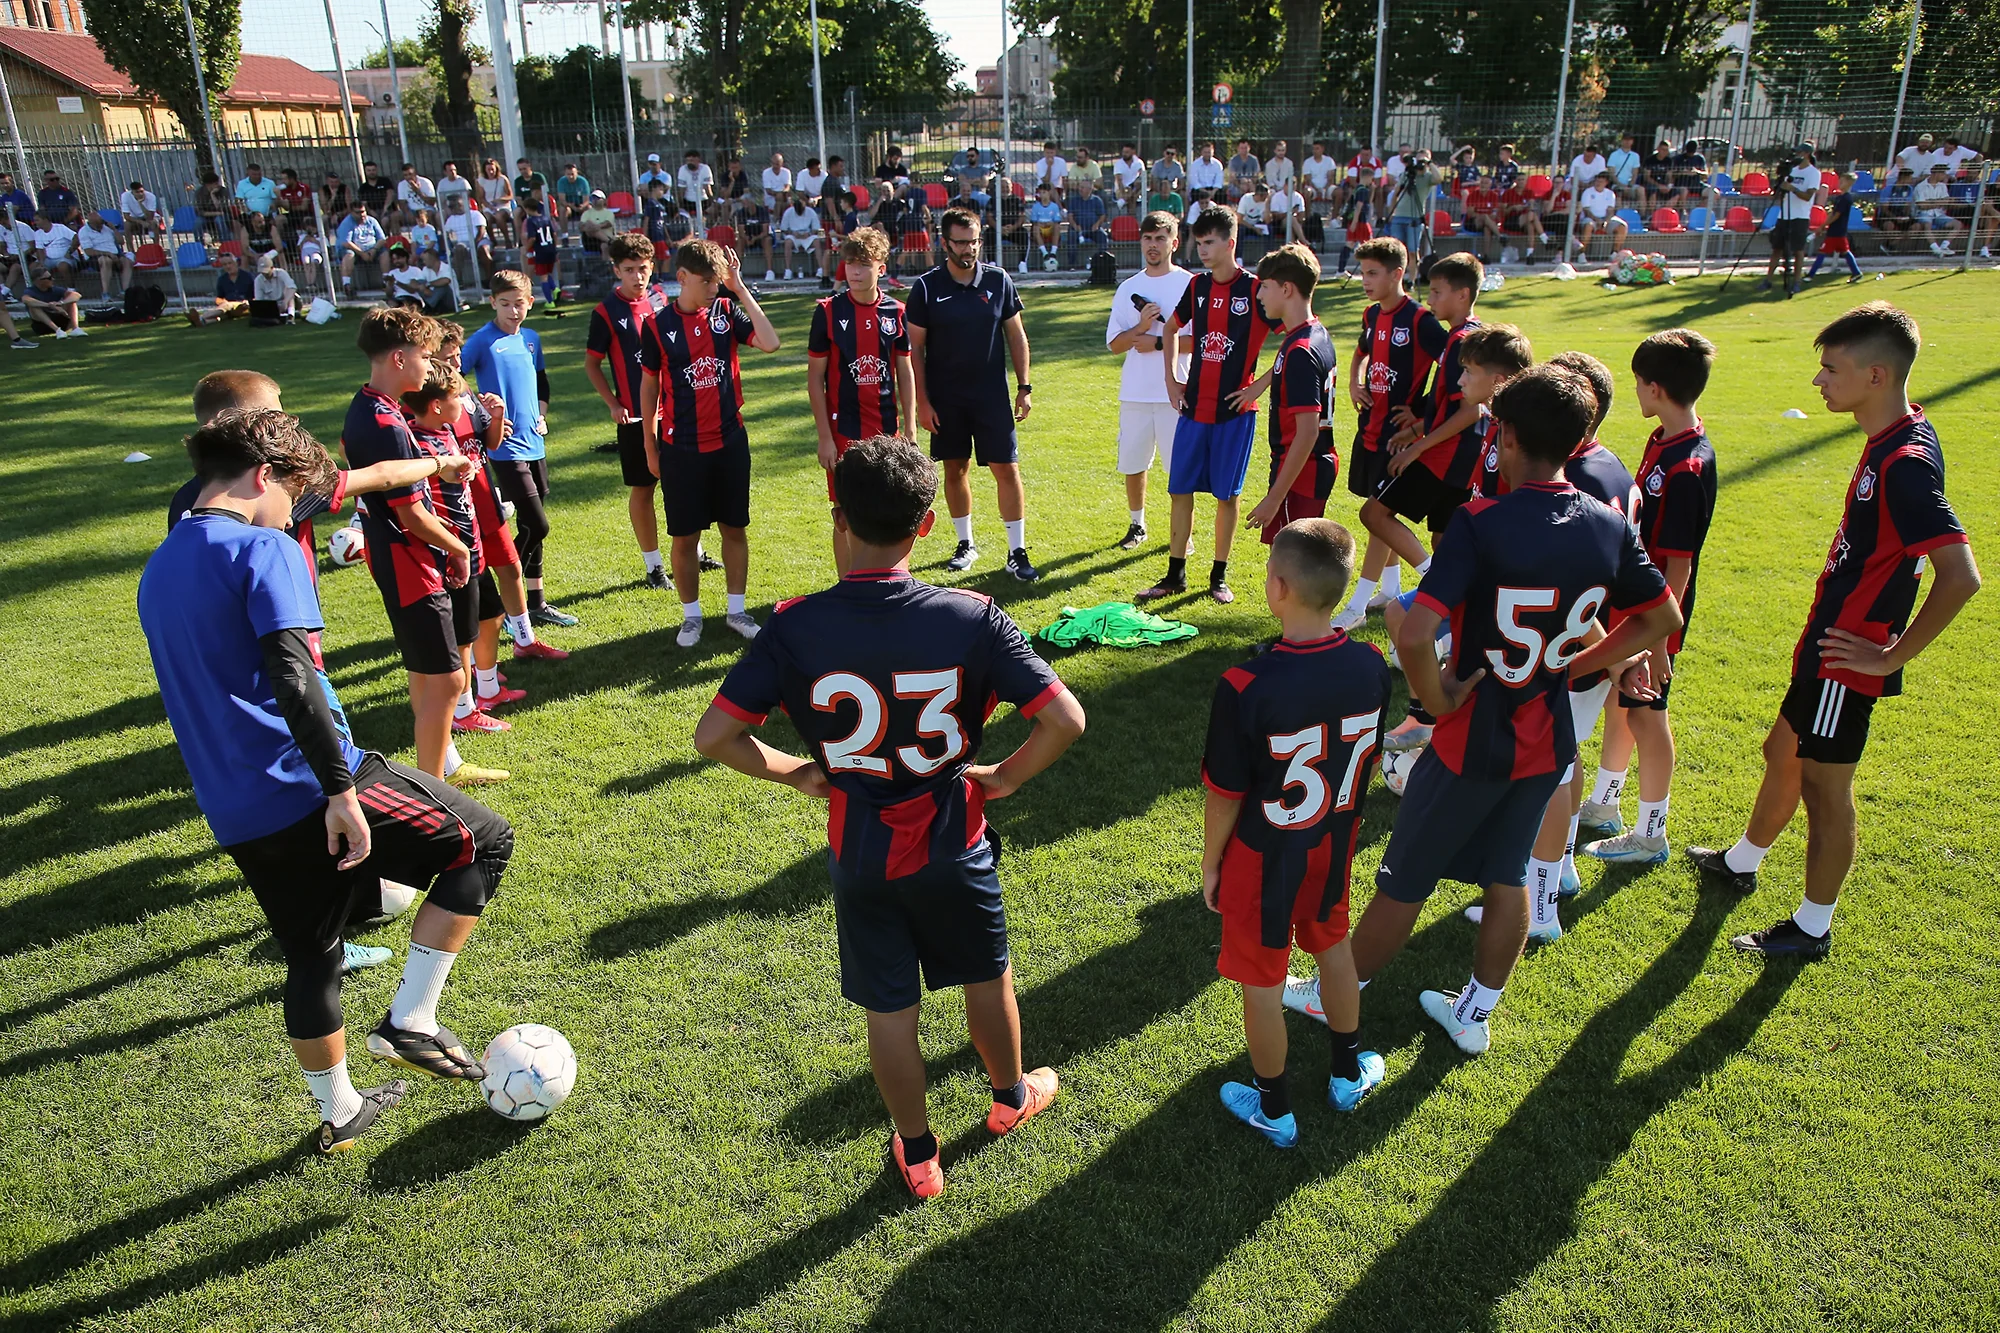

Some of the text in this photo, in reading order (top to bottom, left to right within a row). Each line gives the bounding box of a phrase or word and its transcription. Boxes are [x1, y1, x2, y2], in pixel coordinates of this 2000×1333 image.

[537, 226, 553, 246] 14
[1212, 298, 1224, 309] 27
[694, 326, 701, 337] 6
[865, 319, 872, 330] 5
[1378, 330, 1386, 340] 16
[1483, 585, 1608, 689] 58
[810, 666, 970, 780] 23
[1261, 706, 1382, 830] 37
